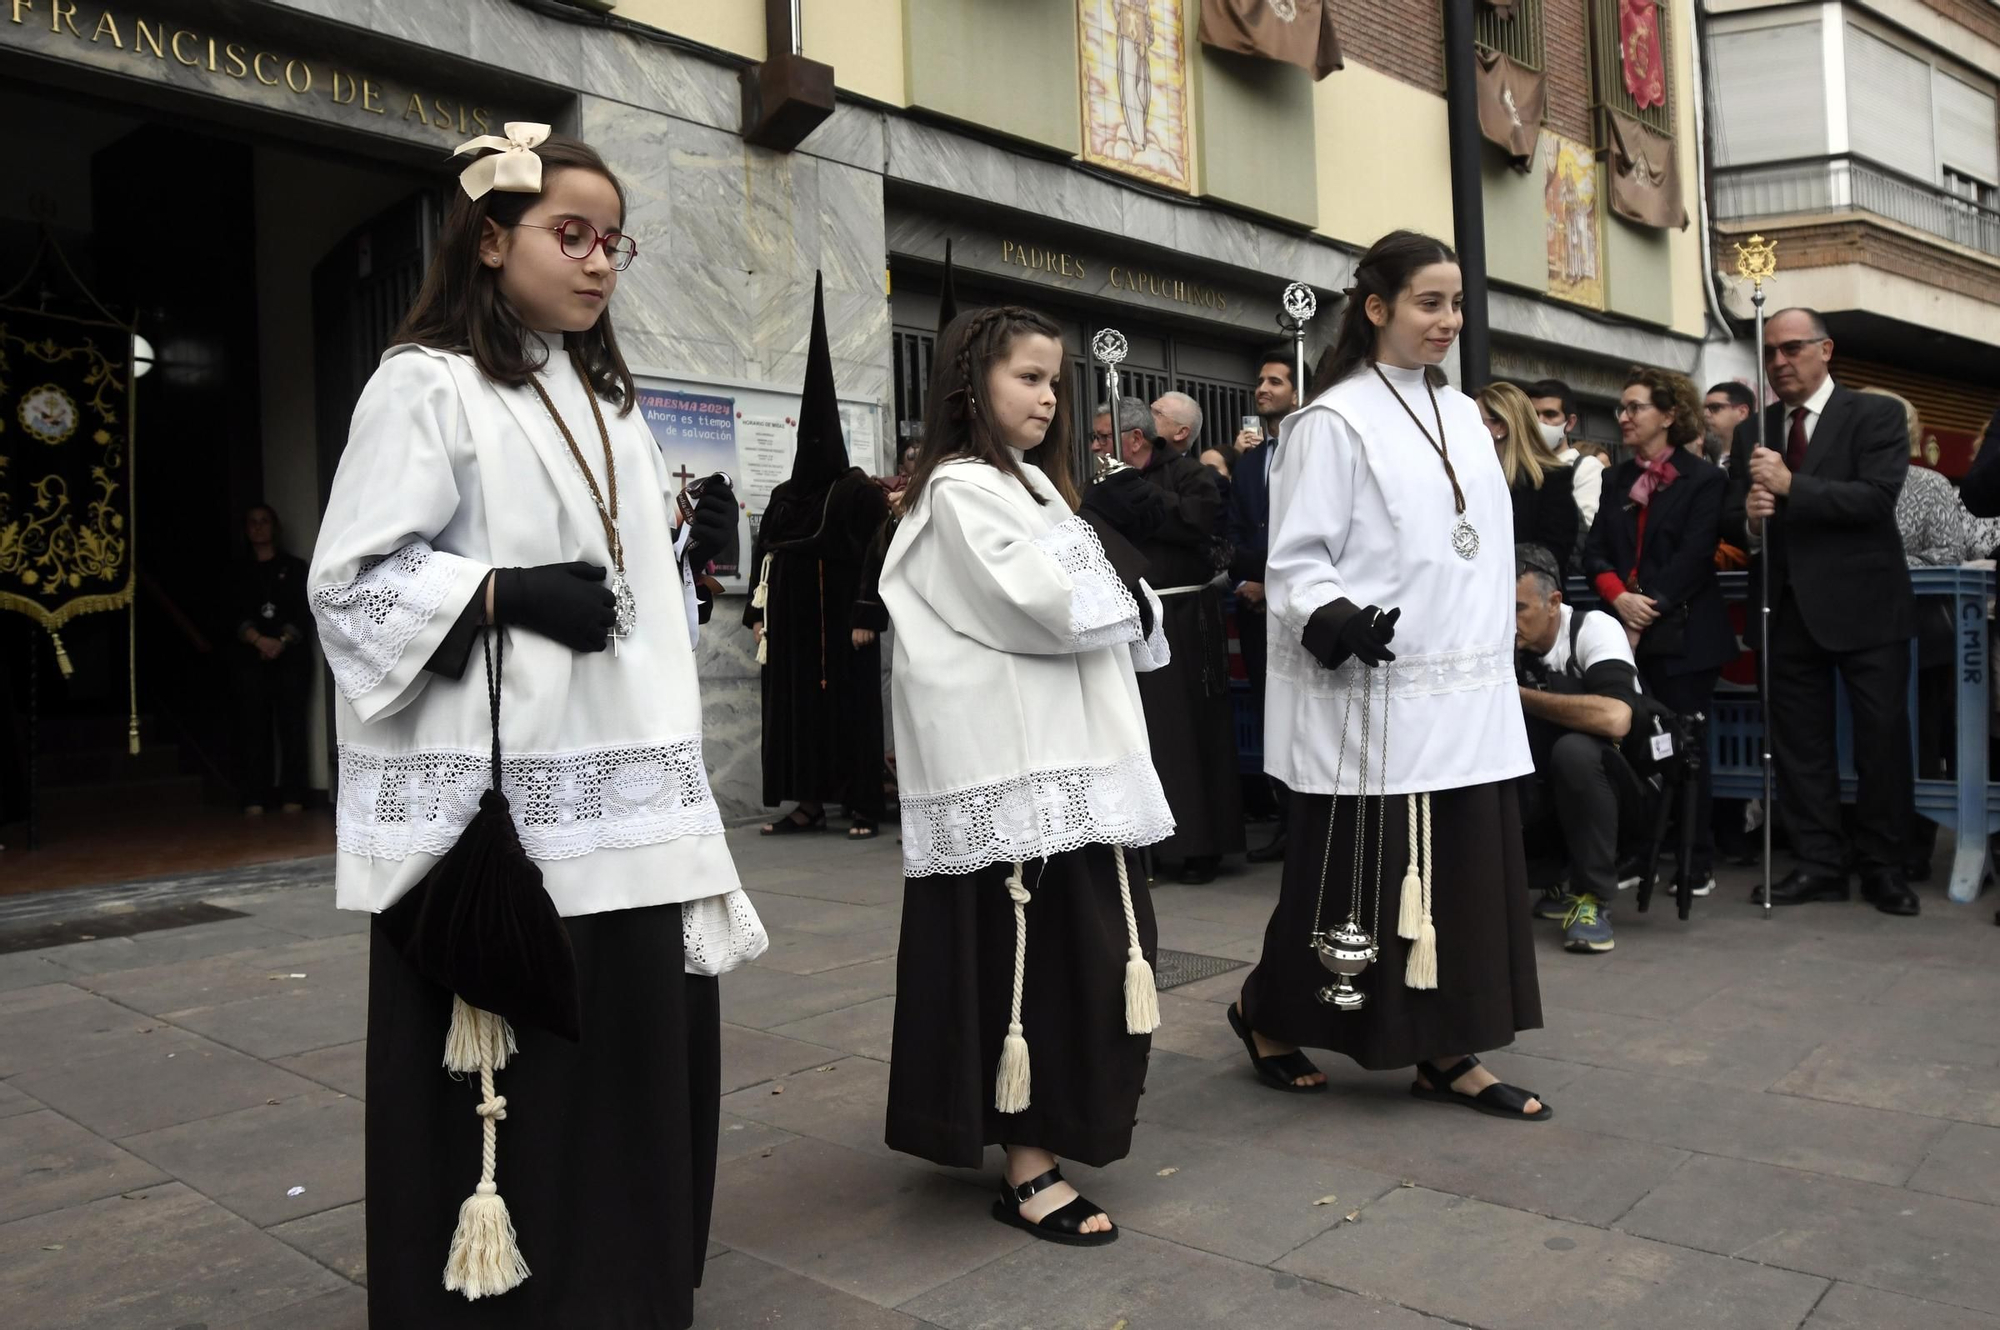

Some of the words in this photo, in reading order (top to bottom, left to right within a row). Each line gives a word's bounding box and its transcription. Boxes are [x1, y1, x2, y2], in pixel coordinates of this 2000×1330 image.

[9, 0, 312, 93] FRANCISCO
[331, 70, 385, 114] DE
[403, 93, 491, 135] ASIS
[1002, 239, 1086, 279] PADRES
[1109, 266, 1227, 311] CAPUCHINOS
[699, 402, 730, 415] 2024
[647, 410, 677, 422] Ahora
[681, 416, 693, 424] es
[699, 415, 731, 429] tiempo
[666, 425, 677, 435] de
[682, 428, 732, 441] salvación
